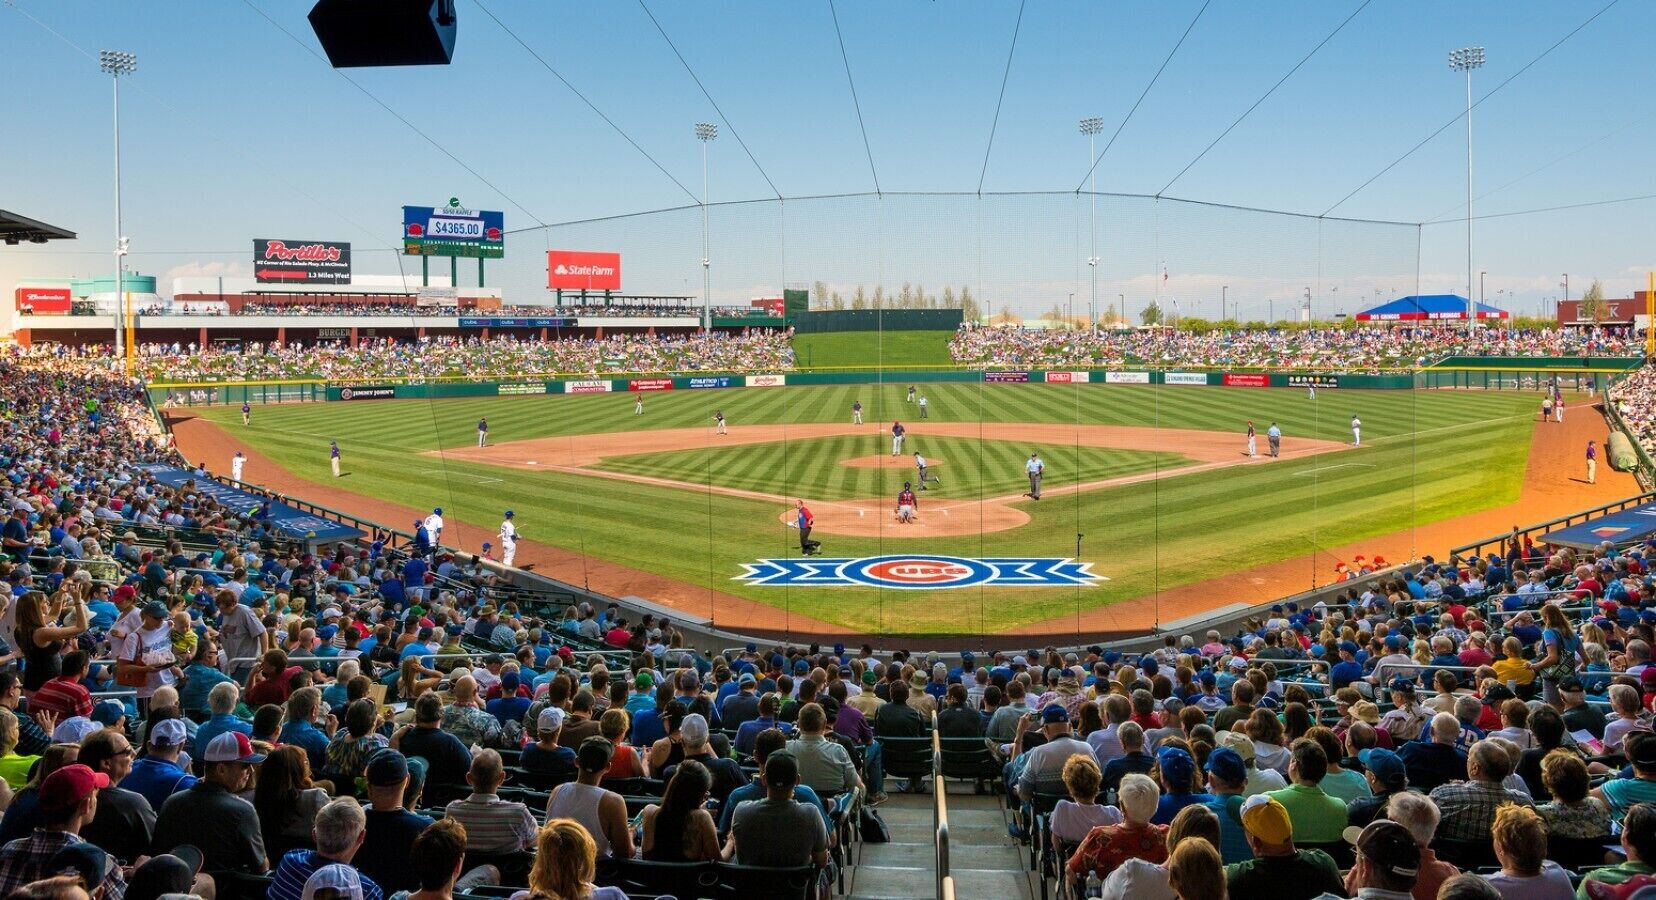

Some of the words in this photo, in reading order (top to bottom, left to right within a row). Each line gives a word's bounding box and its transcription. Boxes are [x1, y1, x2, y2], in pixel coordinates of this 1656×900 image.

[435, 221, 479, 235] $4365.00
[265, 240, 341, 261] Portillo's
[319, 328, 351, 337] BURGER
